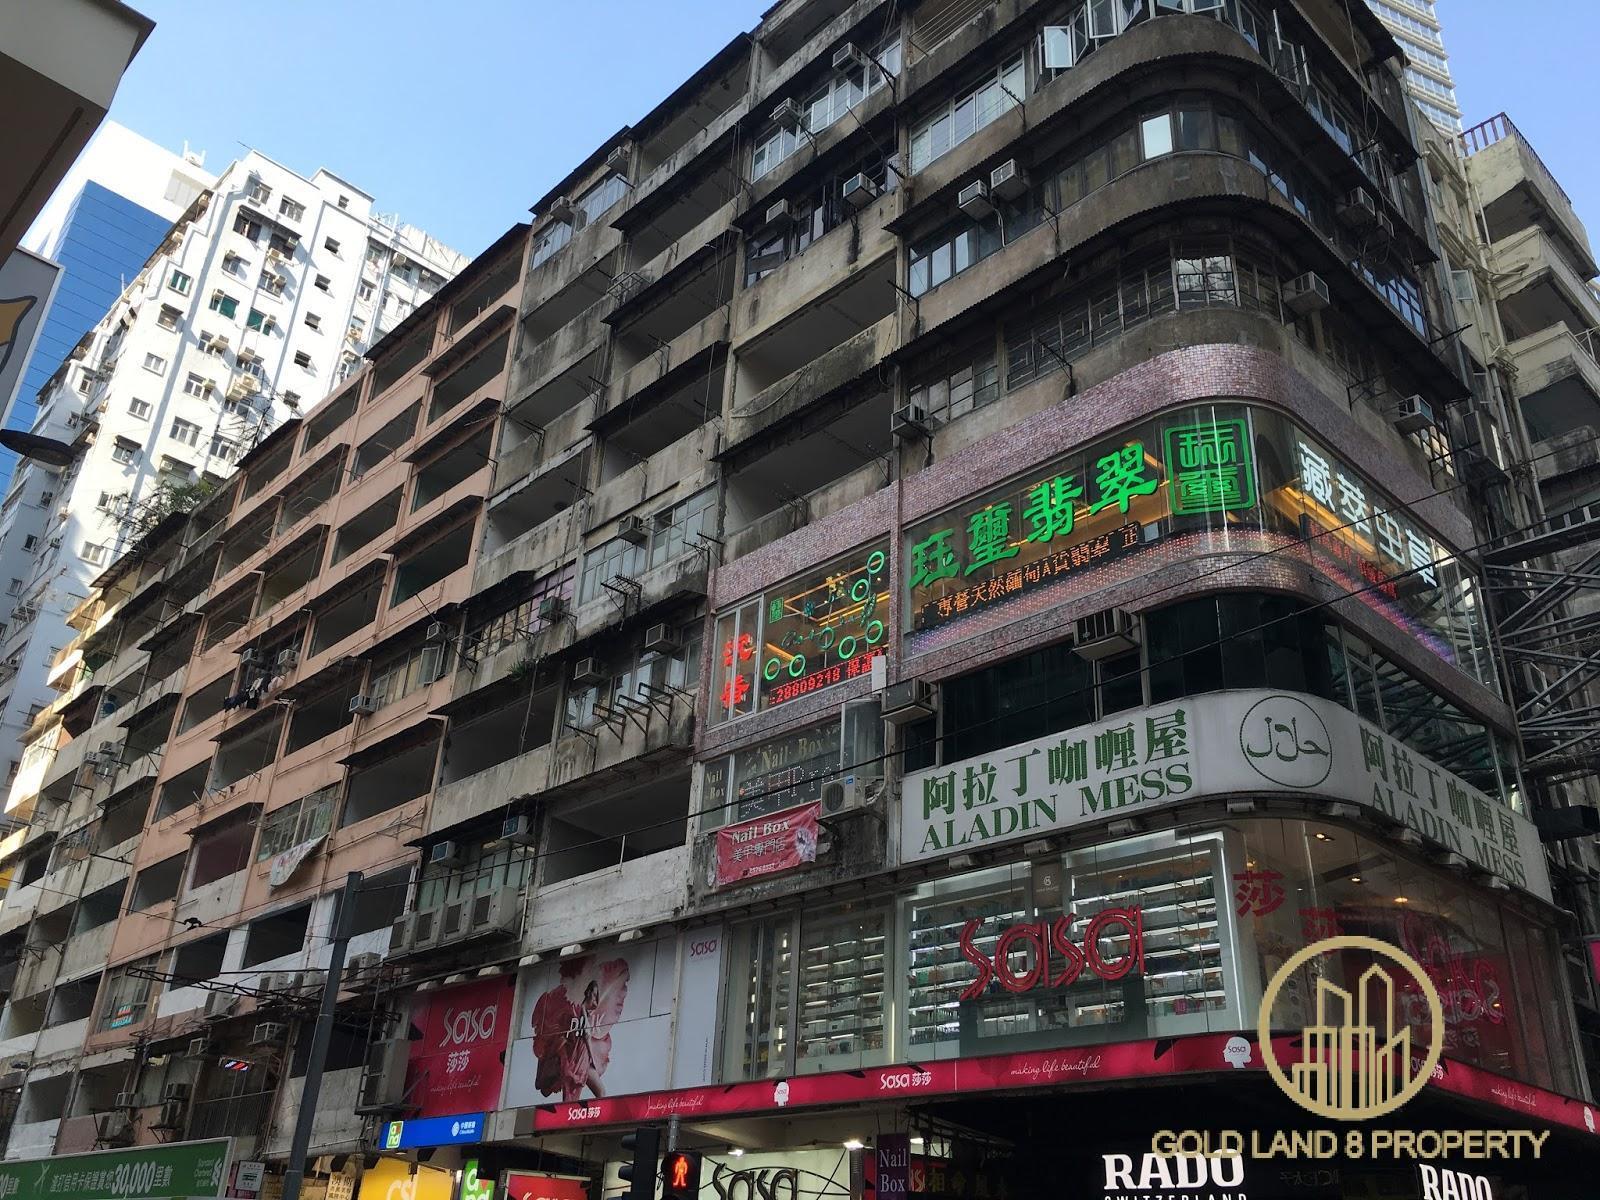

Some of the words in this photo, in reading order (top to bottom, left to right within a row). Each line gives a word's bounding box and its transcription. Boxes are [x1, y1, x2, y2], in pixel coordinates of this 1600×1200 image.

[1246, 716, 1329, 762] حلال
[762, 745, 790, 773] Nail
[798, 737, 825, 758] Box
[706, 769, 723, 784] Nail
[710, 787, 725, 800] Box
[919, 793, 1058, 854] ALADIN
[1079, 762, 1194, 817] MESS
[731, 828, 759, 845] Nail
[762, 819, 791, 836] Box
[1371, 782, 1463, 852] ALADIN
[1471, 834, 1528, 889] MESS
[446, 1049, 471, 1073] 莎莎
[1010, 1063, 1041, 1081] making
[1041, 1060, 1061, 1081] life
[1059, 1055, 1101, 1077] beautiful
[912, 1071, 931, 1087] 莎莎
[879, 1150, 908, 1168] Nail
[1101, 1148, 1245, 1190] RADO
[880, 1174, 906, 1192] Box
[1418, 1163, 1494, 1200] RADO
